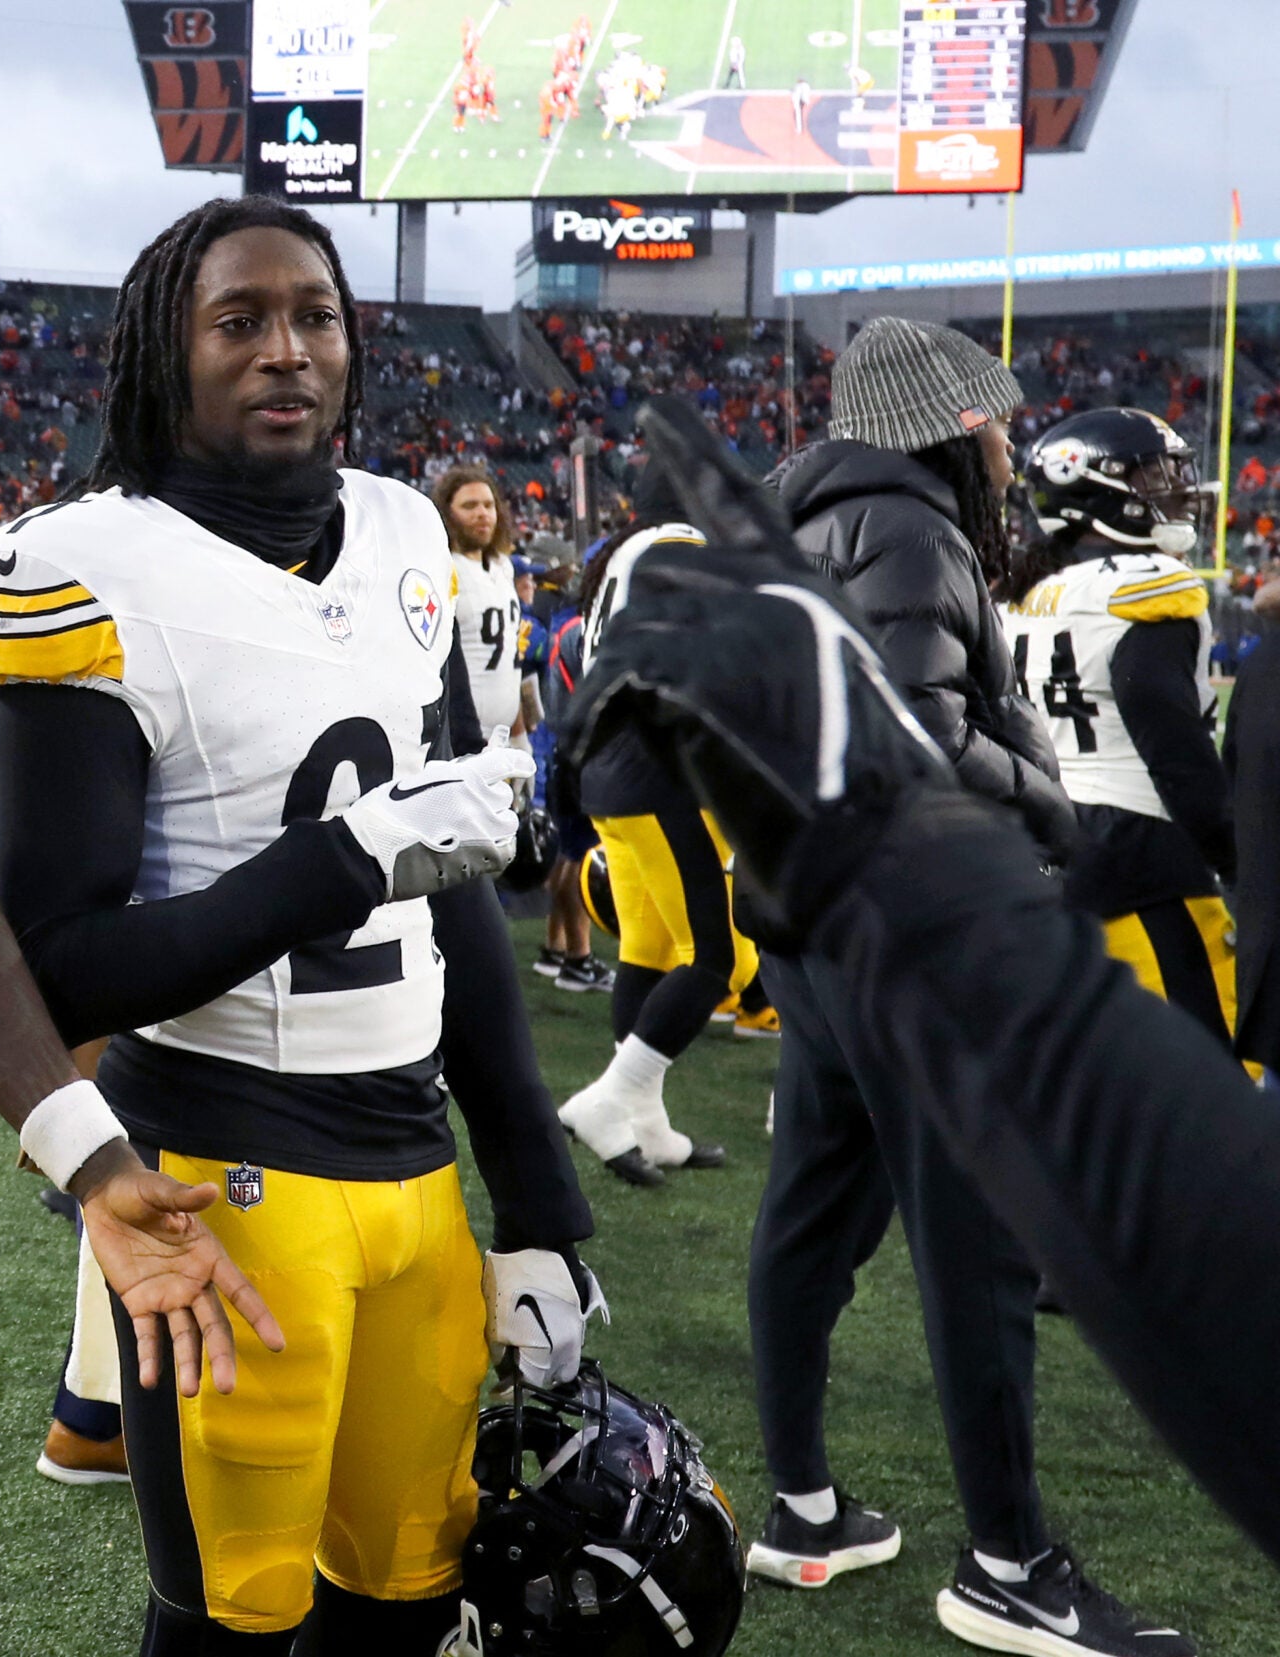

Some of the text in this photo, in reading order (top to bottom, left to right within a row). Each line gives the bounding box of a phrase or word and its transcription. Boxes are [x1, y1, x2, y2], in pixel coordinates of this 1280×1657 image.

[553, 210, 694, 250] Paycor
[616, 242, 695, 260] STADIUM
[821, 267, 858, 287] PUT
[861, 264, 904, 285] OUR
[907, 258, 1010, 282] FINANCIAL
[1014, 251, 1121, 276] STRENGTH
[1125, 246, 1207, 269] BEHIND
[232, 1183, 258, 1201] NFL
